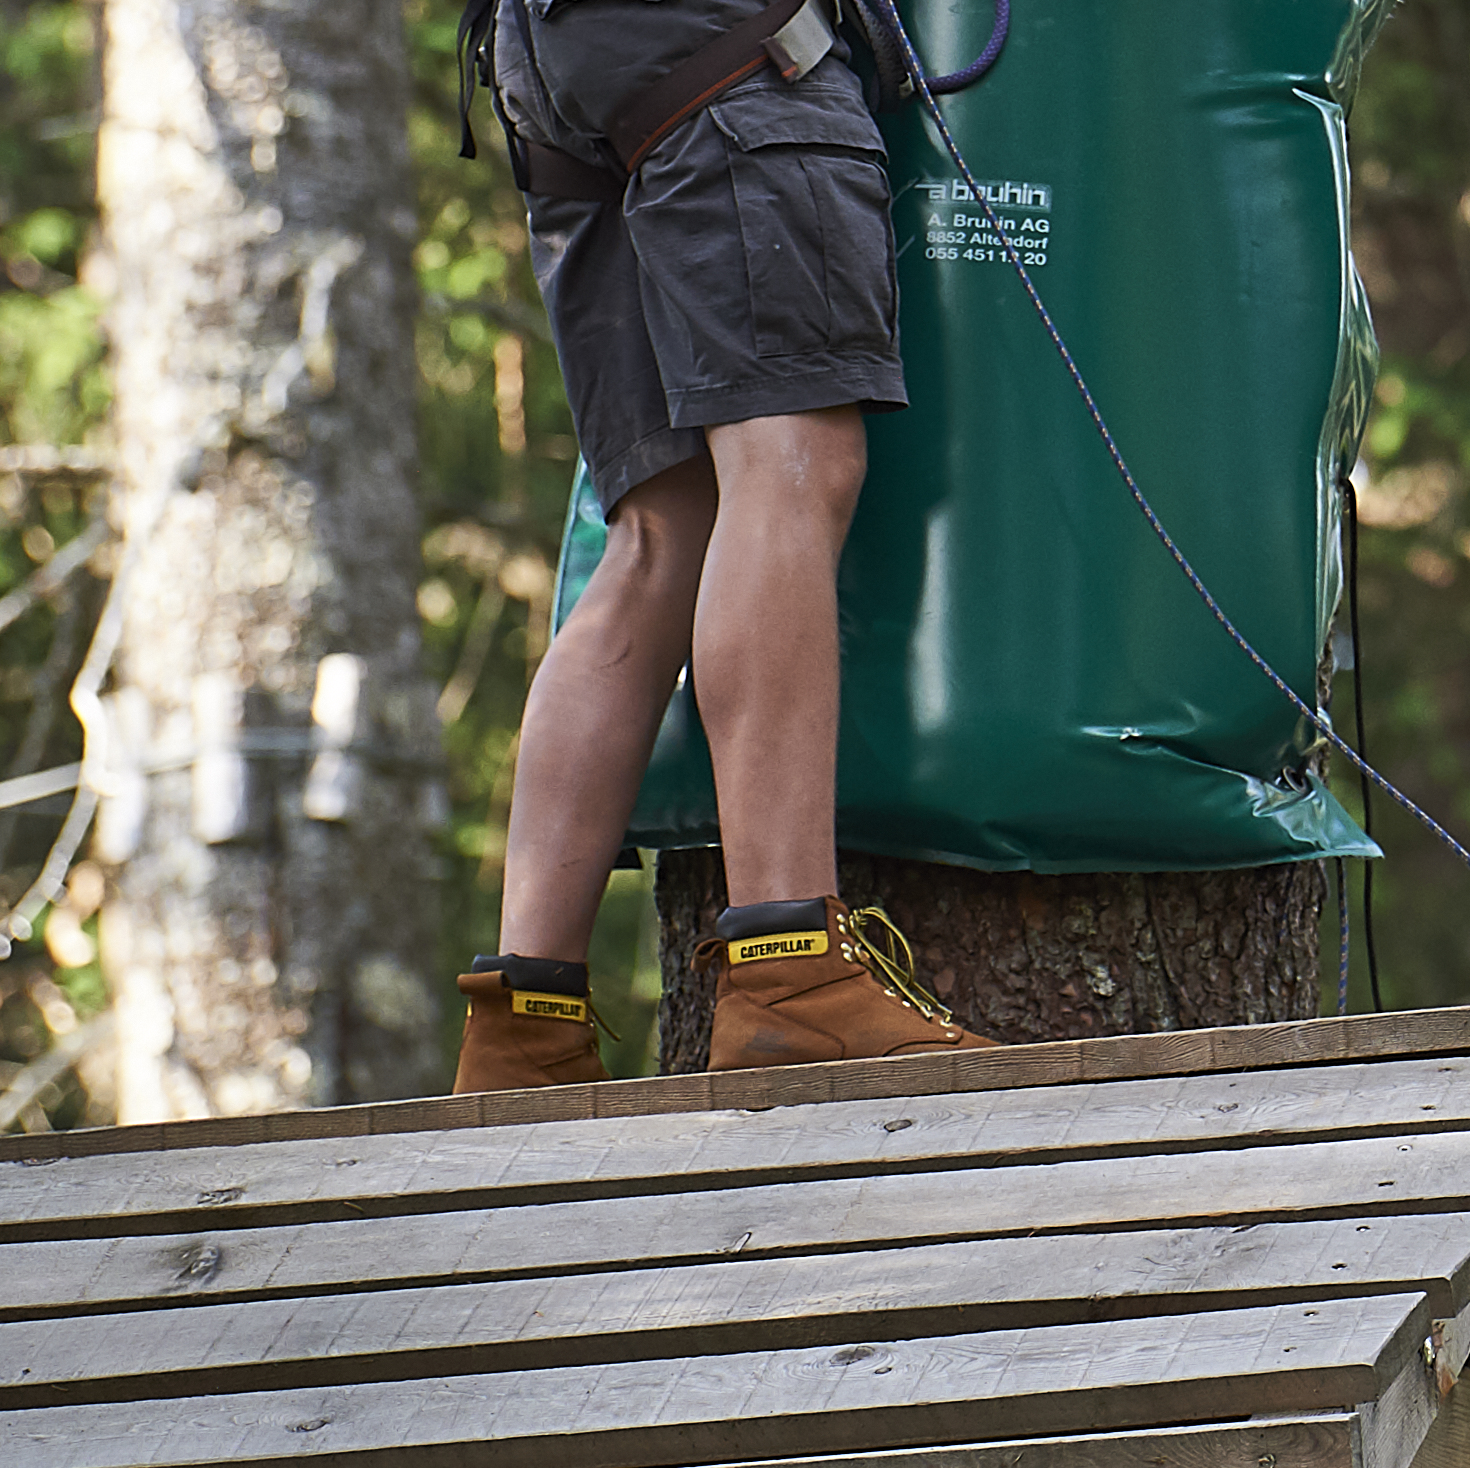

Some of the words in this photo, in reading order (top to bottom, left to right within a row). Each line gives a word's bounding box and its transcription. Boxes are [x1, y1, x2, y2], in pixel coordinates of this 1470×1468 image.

[953, 213, 1016, 231] Bruin
[1020, 218, 1050, 233] AG
[925, 231, 966, 244] 8852
[925, 246, 958, 260] 055
[962, 249, 994, 262] 451
[1023, 252, 1047, 266] 20
[740, 938, 812, 959] CATERPILLAR
